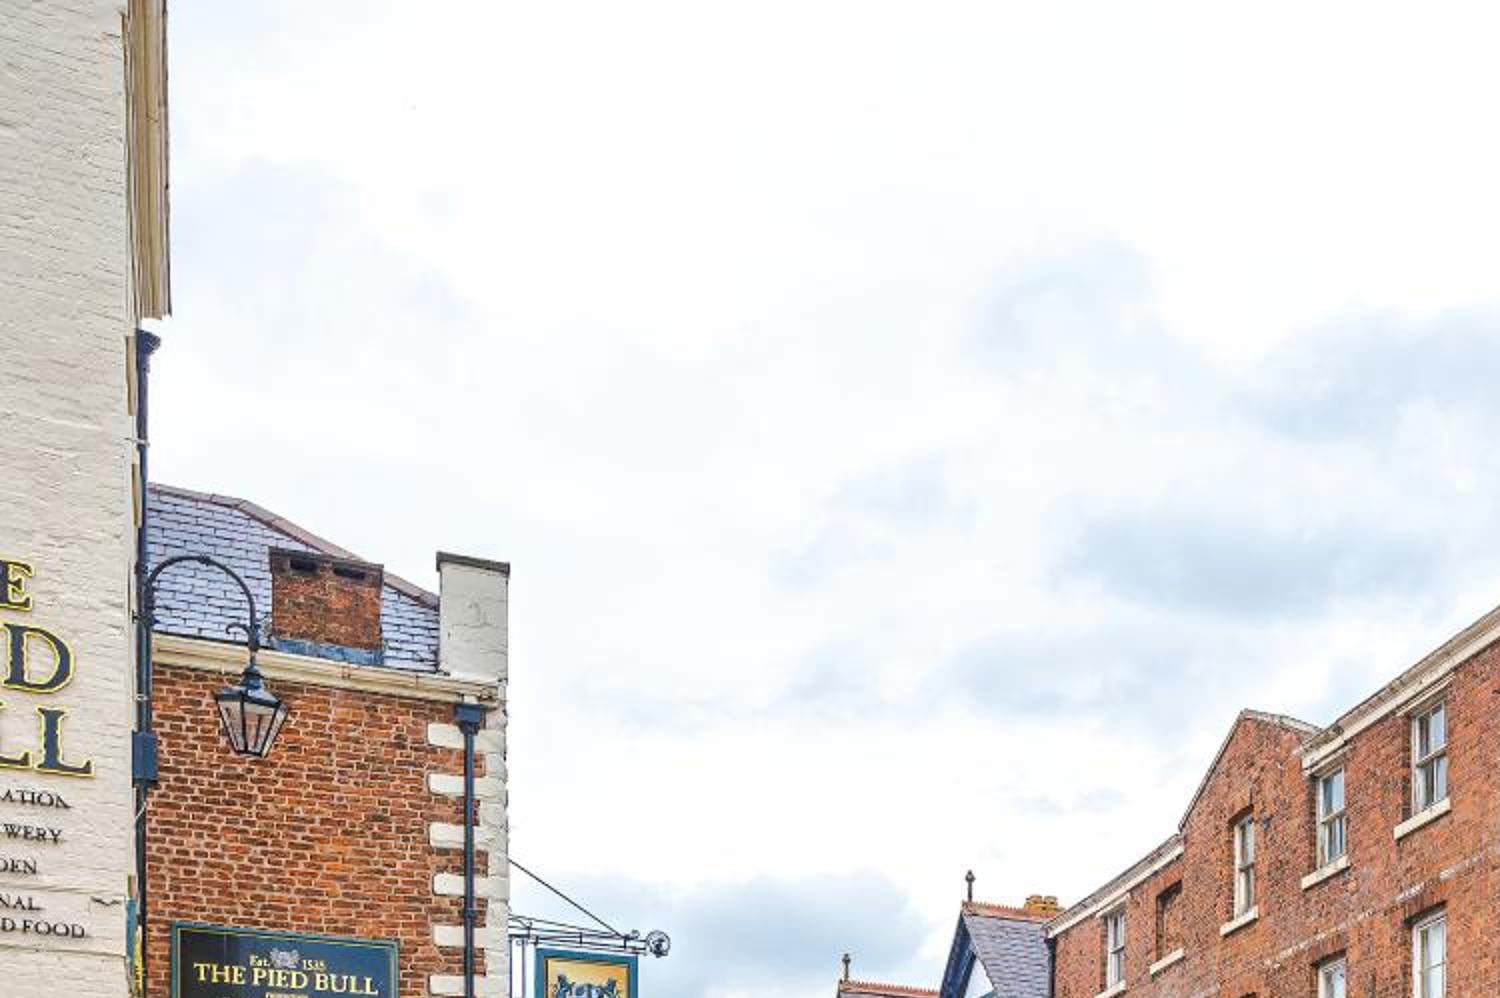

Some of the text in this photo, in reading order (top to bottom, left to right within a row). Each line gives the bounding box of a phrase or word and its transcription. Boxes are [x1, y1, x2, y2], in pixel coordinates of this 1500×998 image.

[23, 919, 85, 938] FOOD
[194, 963, 379, 996] THE PIED BULL
